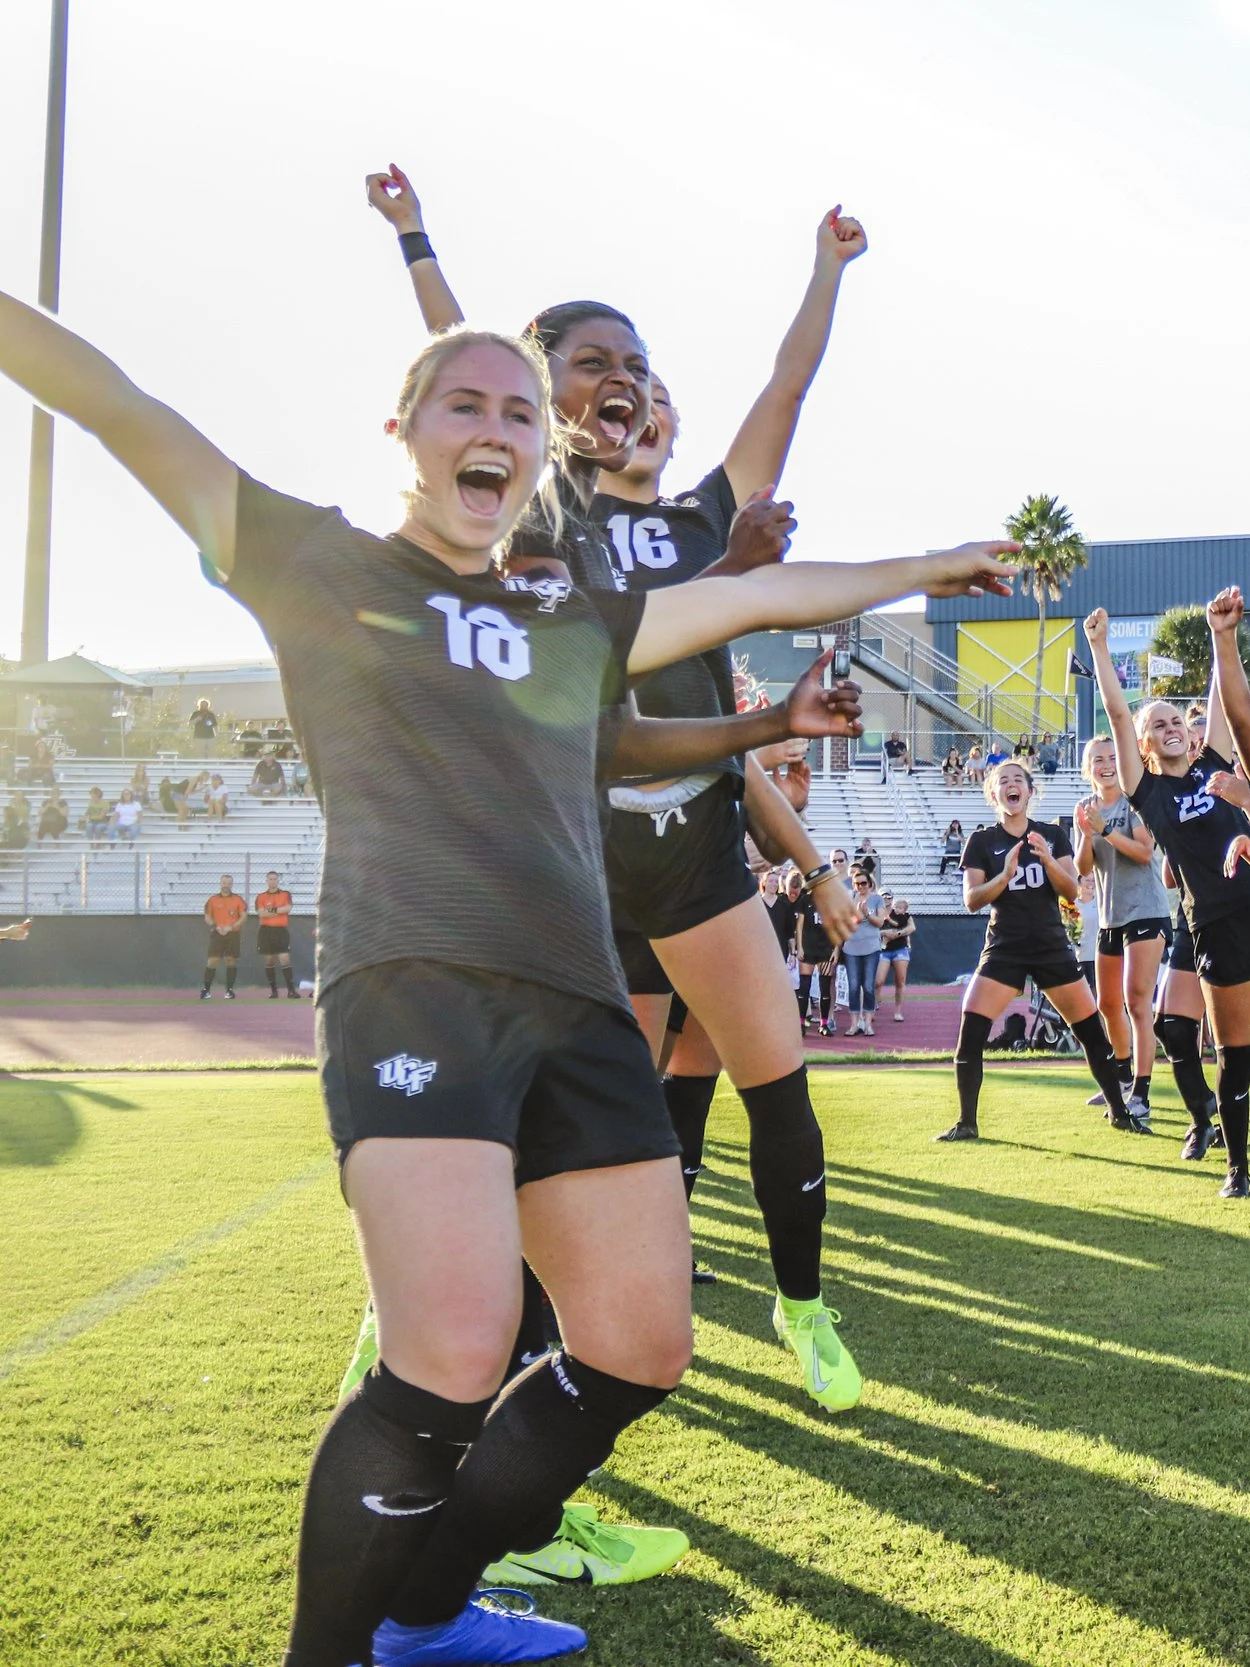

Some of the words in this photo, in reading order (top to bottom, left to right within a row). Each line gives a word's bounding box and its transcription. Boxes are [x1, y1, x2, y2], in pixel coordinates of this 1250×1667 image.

[607, 514, 678, 571] 16
[1173, 786, 1215, 823] 25
[1008, 862, 1044, 891] 20
[373, 1053, 437, 1097] UCF
